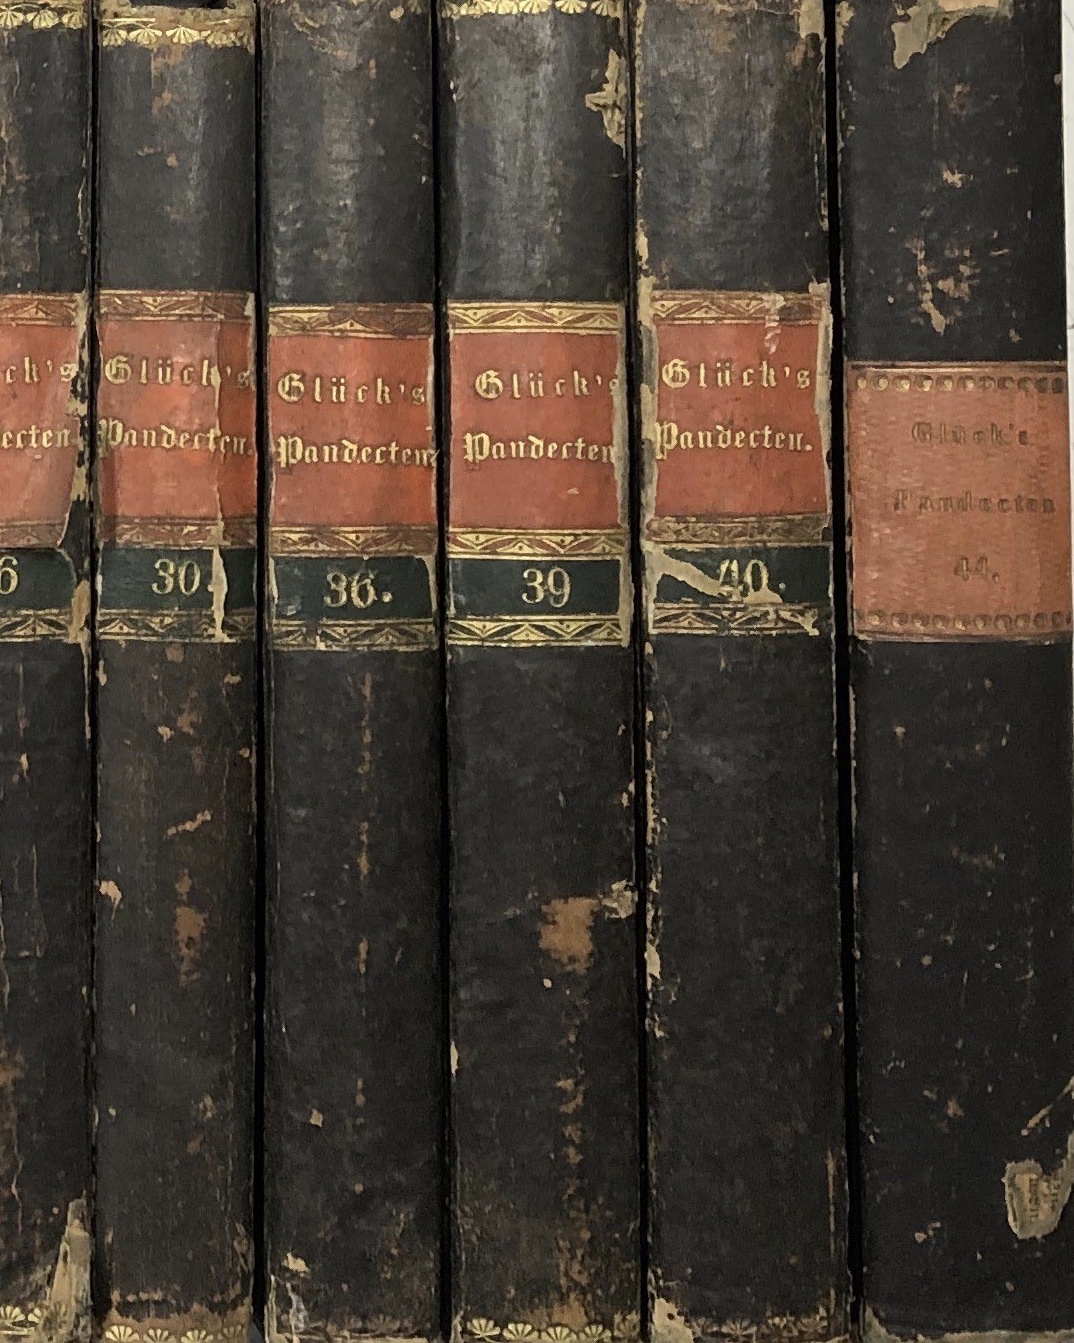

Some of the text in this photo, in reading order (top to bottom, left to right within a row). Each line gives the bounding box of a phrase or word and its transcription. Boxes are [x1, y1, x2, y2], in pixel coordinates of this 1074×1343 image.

[277, 372, 426, 405] Glück's
[661, 359, 812, 389] Glück's
[655, 422, 814, 460] Pandecten.
[323, 570, 394, 609] 36.
[521, 566, 571, 608] 39
